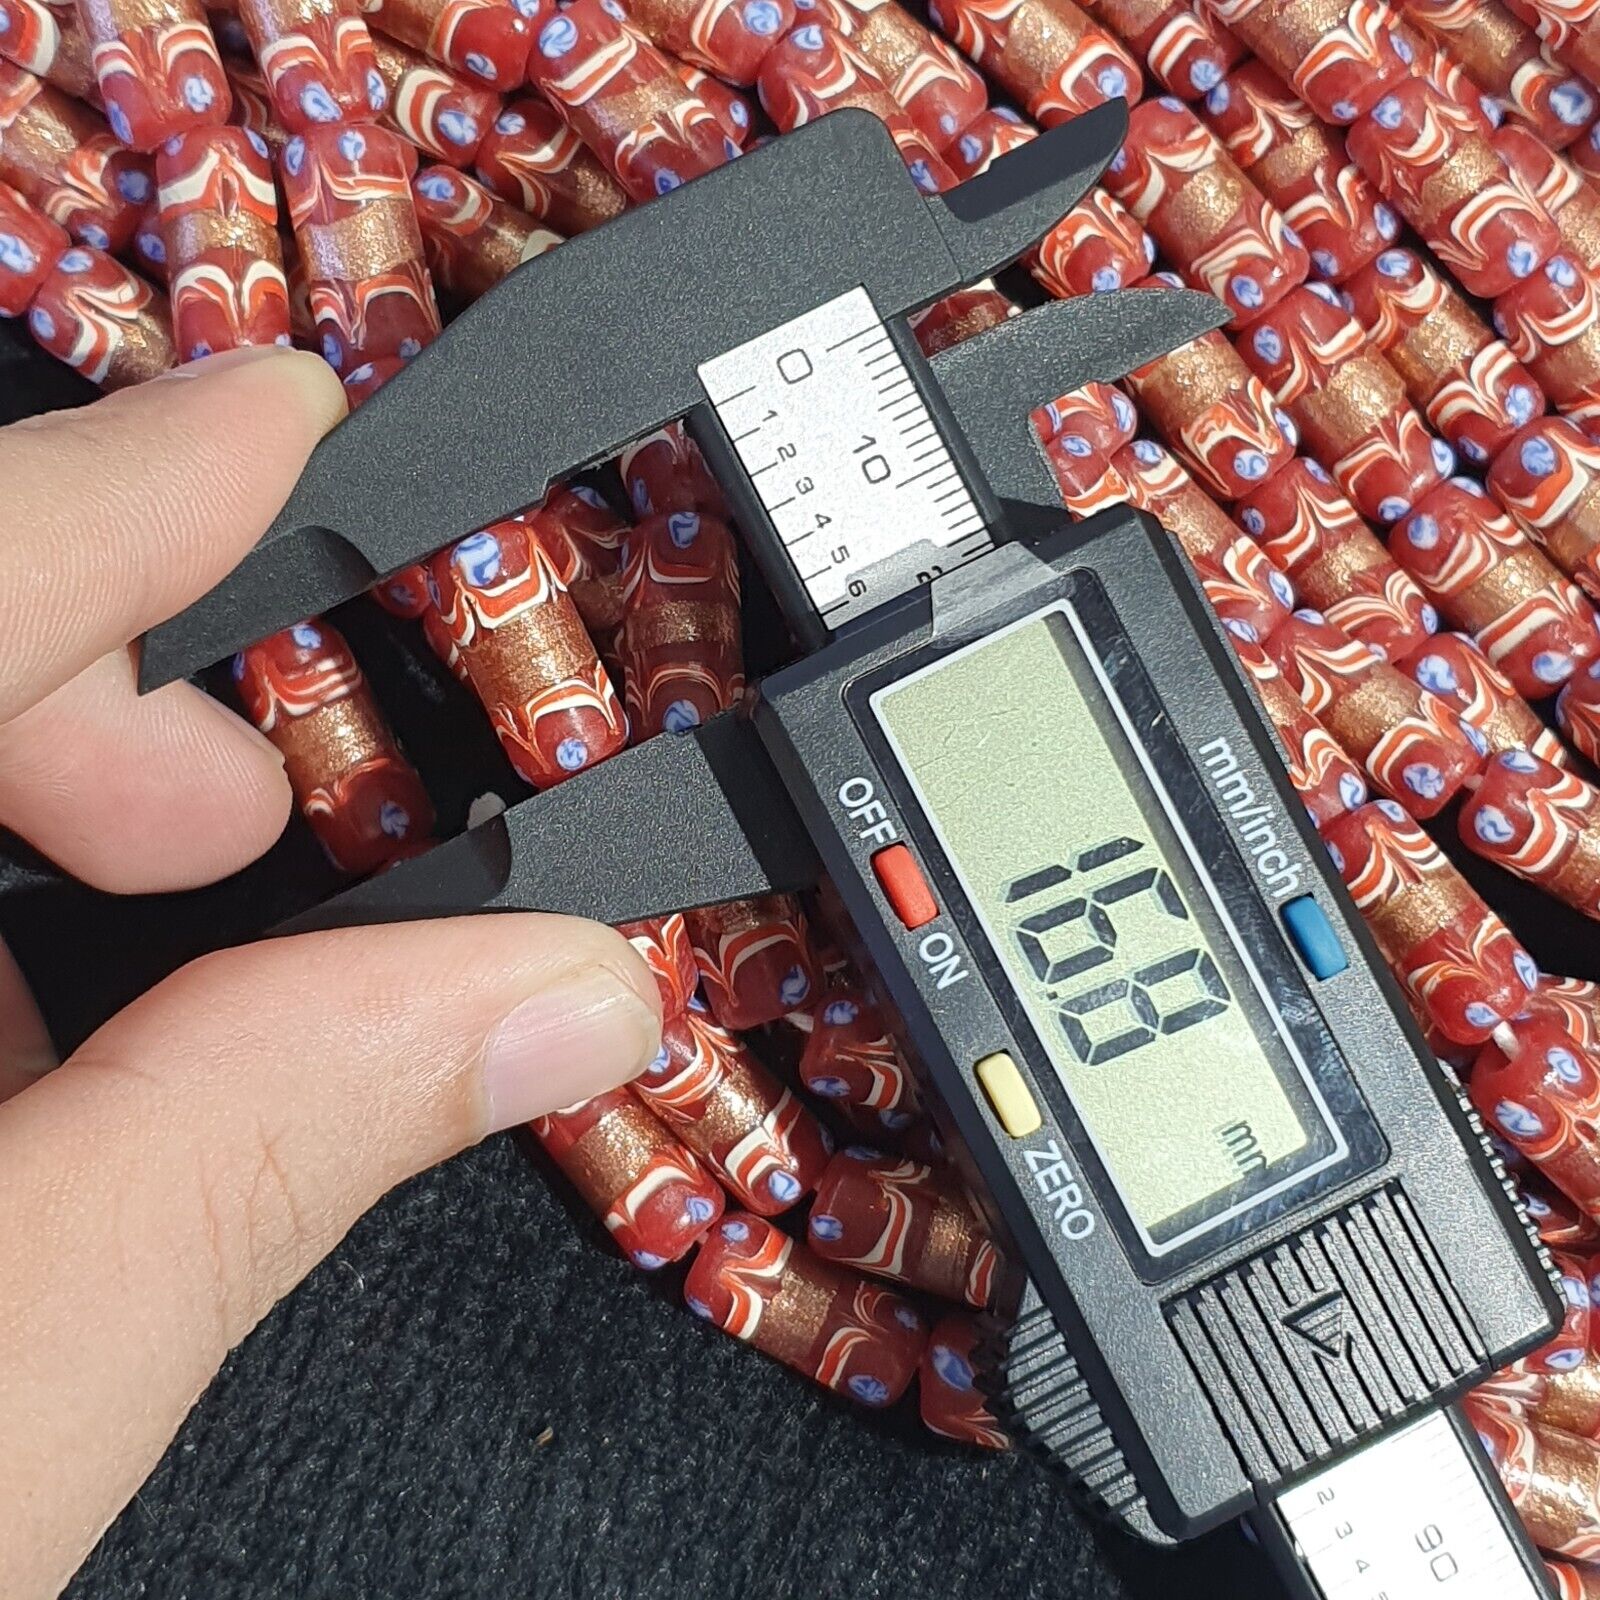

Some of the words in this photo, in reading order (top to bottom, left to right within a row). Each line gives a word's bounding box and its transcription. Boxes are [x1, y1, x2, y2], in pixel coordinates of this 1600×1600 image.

[776, 348, 813, 385] 0
[852, 434, 892, 484] 10
[762, 409, 779, 422] 1
[776, 443, 797, 462] 2
[795, 476, 815, 496] 3
[814, 512, 832, 530] 4
[830, 545, 850, 565] 5
[847, 579, 867, 598] 6
[838, 776, 900, 845] OFF
[1198, 737, 1303, 898] mm/inch
[918, 931, 970, 990] ON
[1003, 836, 1232, 1067] 16.8
[1023, 1139, 1096, 1241] ZERO
[1316, 1486, 1335, 1506] 2
[1335, 1520, 1354, 1540] 3
[1413, 1523, 1459, 1583] 90
